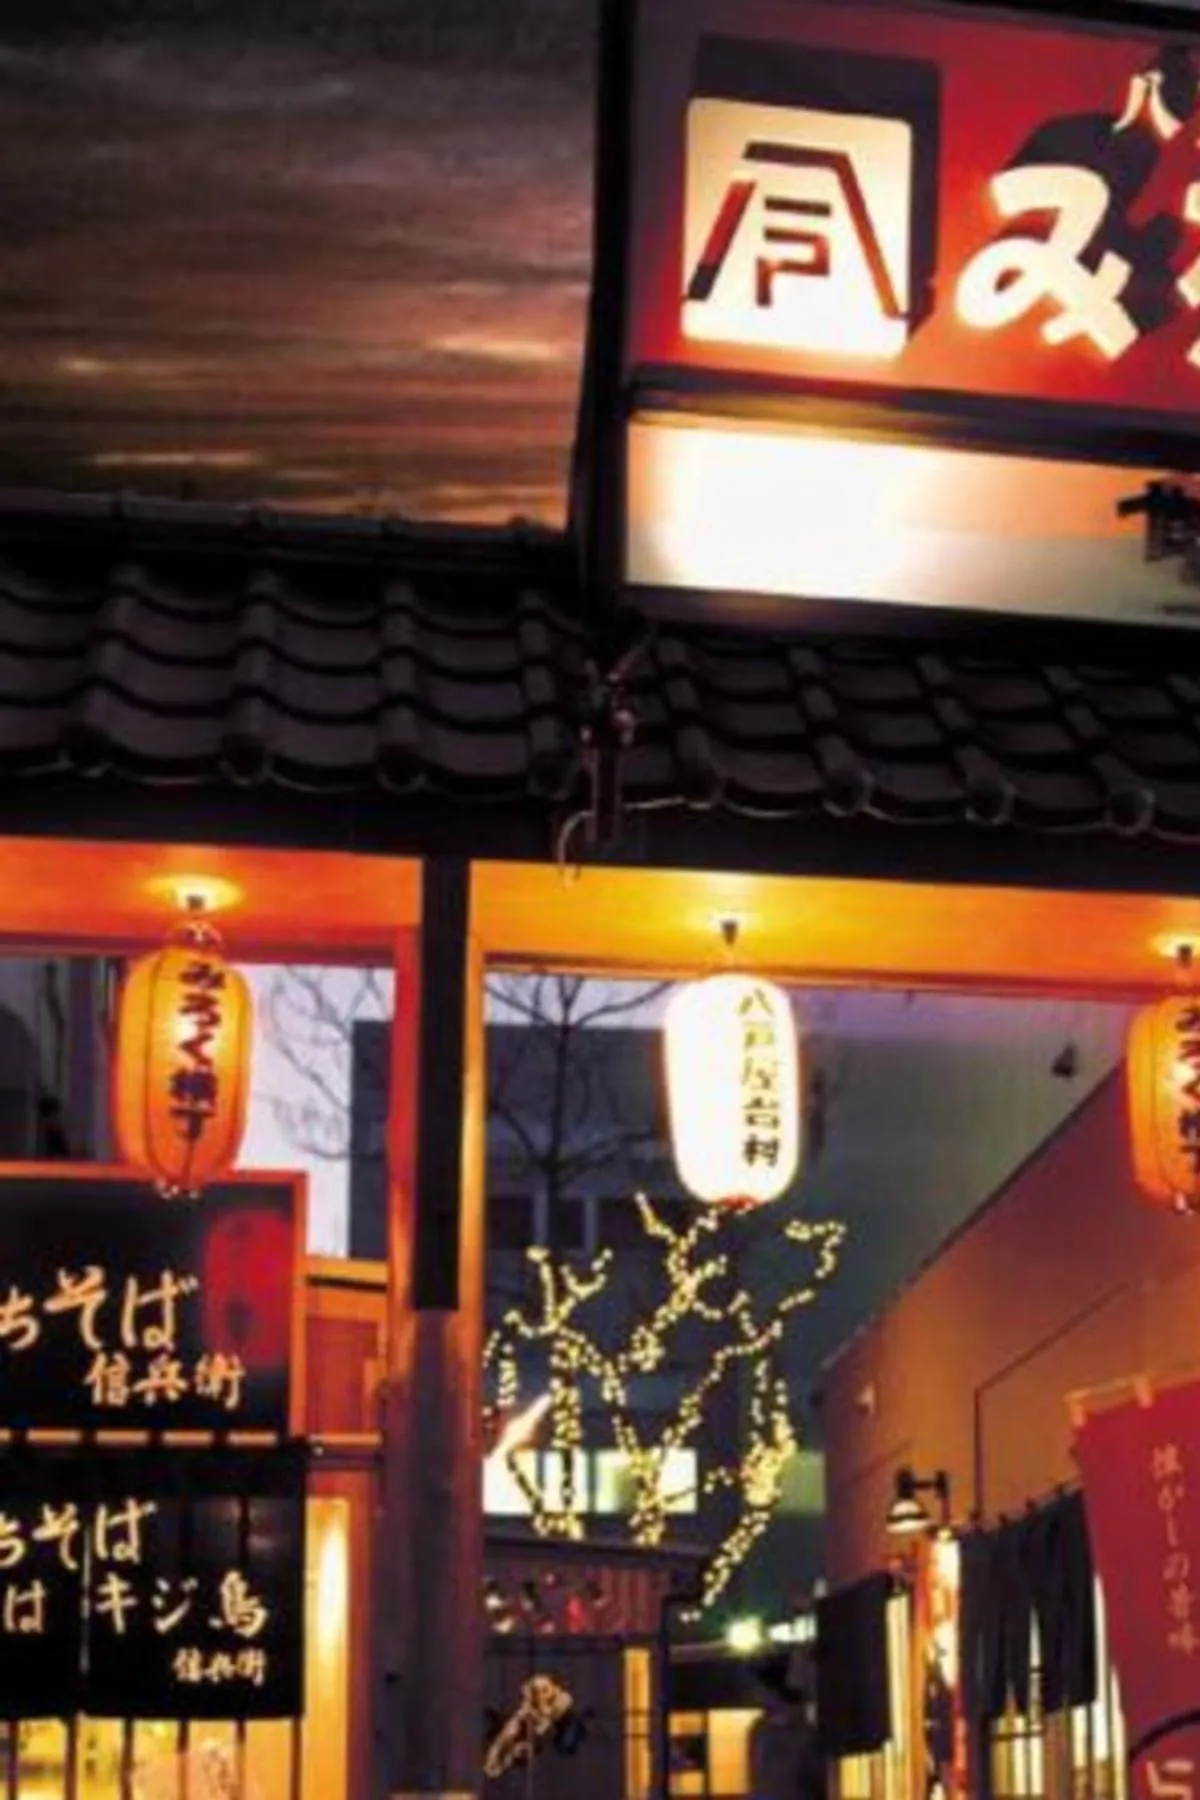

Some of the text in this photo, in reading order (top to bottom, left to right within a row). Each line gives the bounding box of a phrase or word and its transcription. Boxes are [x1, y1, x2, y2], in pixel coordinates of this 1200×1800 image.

[170, 962, 226, 1142] みろく横丁
